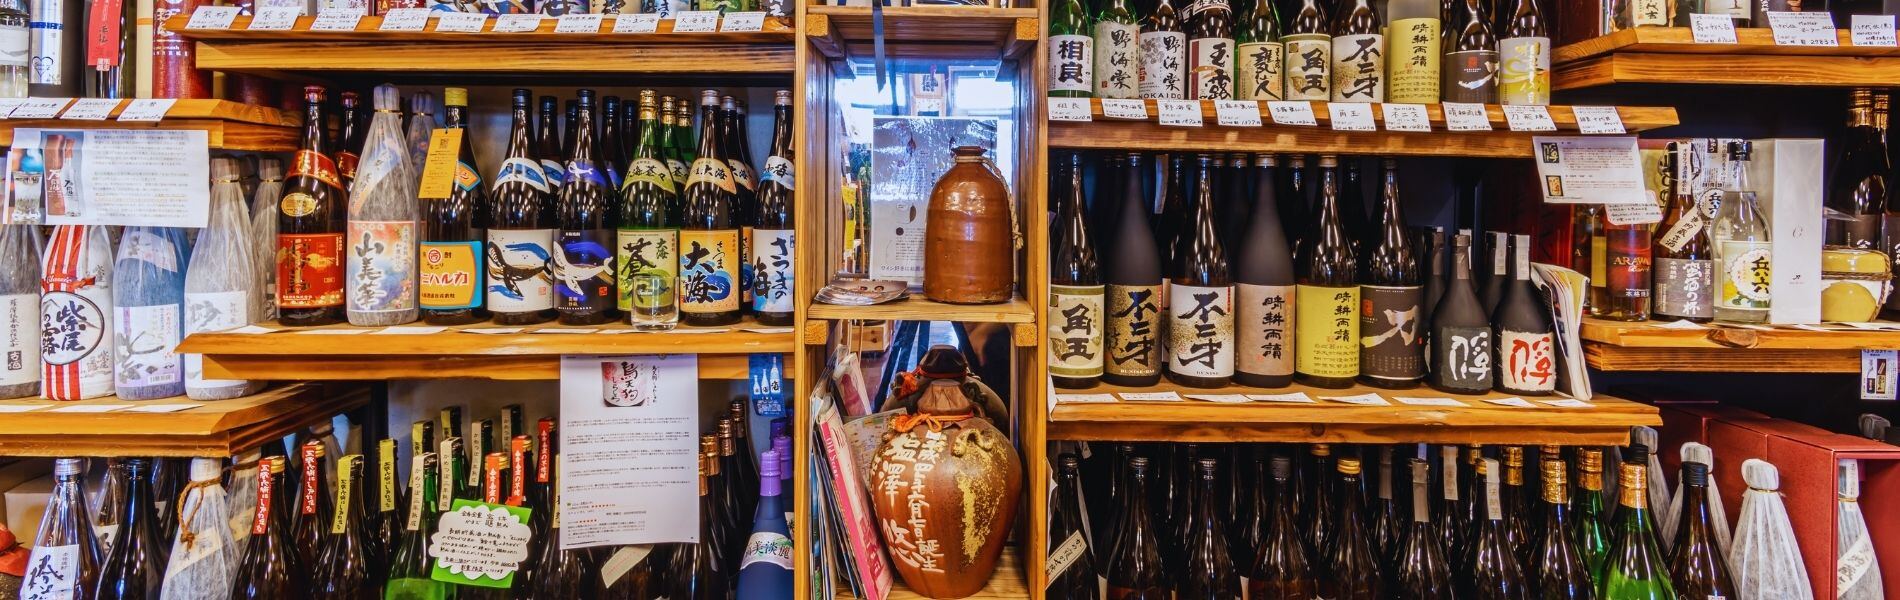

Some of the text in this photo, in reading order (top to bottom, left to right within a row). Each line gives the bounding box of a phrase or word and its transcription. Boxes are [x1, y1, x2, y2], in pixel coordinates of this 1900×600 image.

[1057, 40, 1084, 84] 相良
[1201, 42, 1233, 100] 玉露
[1301, 48, 1327, 94] 角玉
[1342, 37, 1381, 99] 不二才
[1708, 192, 1721, 215] 兵六
[656, 237, 669, 260] 大海
[683, 240, 718, 304] 大海
[770, 237, 790, 300] さつまの
[1751, 256, 1770, 294] 兵六
[56, 300, 87, 352] 紫尾
[1061, 303, 1095, 361] 角玉
[1111, 288, 1160, 367] 不二才
[1177, 291, 1227, 370] 不二才
